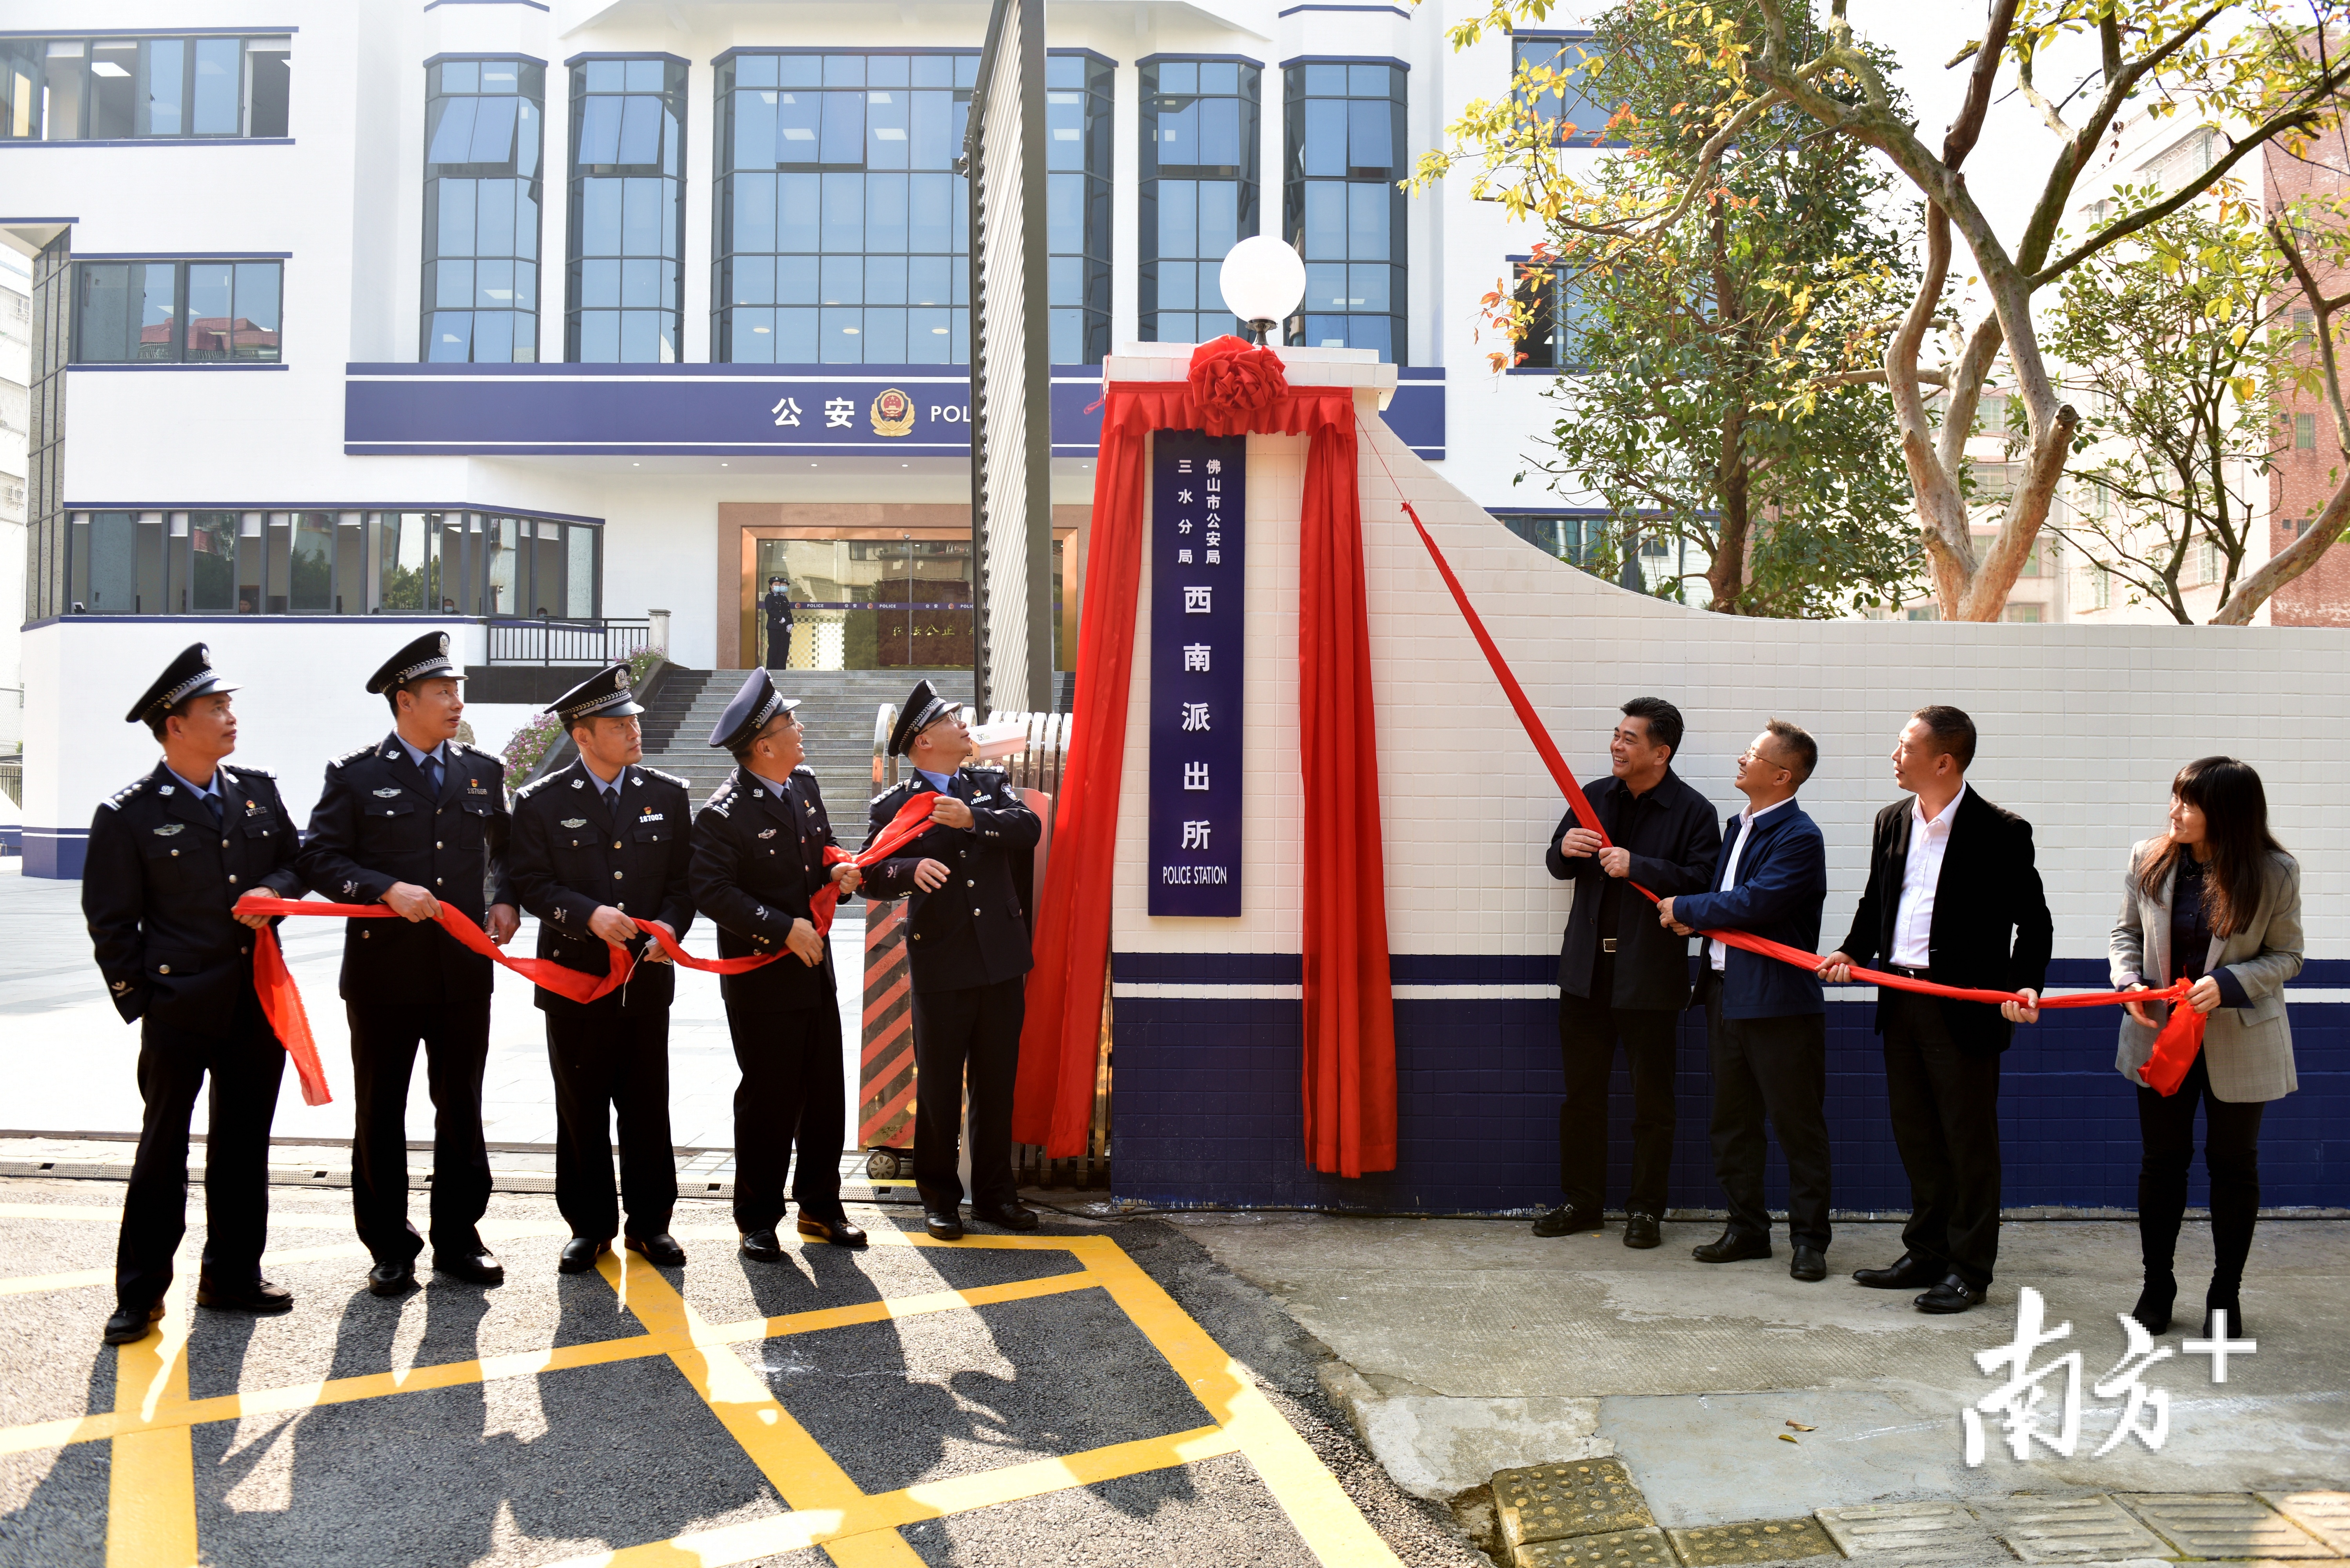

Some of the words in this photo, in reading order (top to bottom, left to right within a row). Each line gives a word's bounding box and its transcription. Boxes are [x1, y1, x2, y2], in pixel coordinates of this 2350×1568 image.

[771, 397, 855, 428] 公安
[1178, 459, 1193, 564] 三水分局
[1205, 459, 1221, 564] 佛山市公安局
[1181, 586, 1212, 850] 西南派出所
[971, 794, 992, 805] 180008
[639, 813, 663, 823] 187002
[1163, 866, 1191, 884] POLICE
[1194, 866, 1227, 885] STATION
